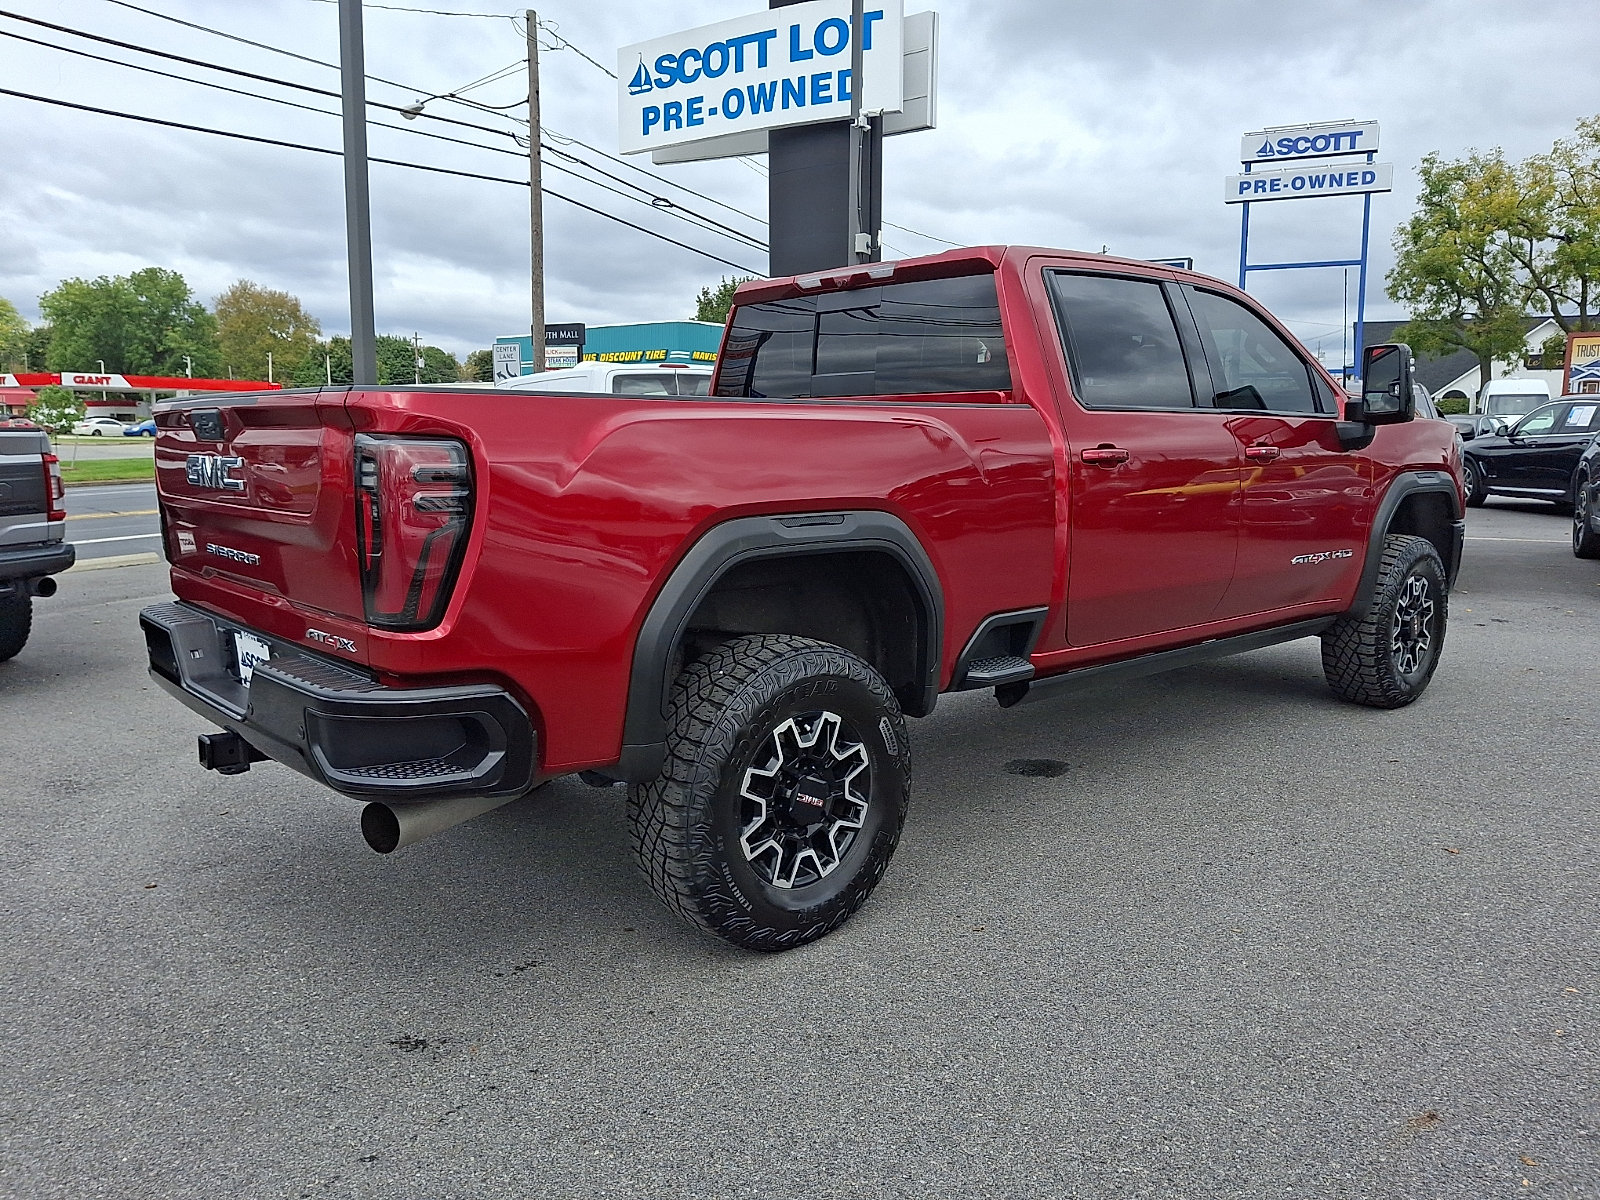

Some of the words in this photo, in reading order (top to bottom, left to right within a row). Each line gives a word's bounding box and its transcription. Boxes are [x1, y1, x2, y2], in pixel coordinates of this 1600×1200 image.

[654, 28, 777, 90] SCOTT
[789, 10, 884, 63] LOT
[1276, 130, 1363, 155] SCOTT
[1238, 170, 1376, 195] PRE-OWNED
[559, 330, 579, 339] MALL
[583, 353, 597, 361] VIS
[599, 351, 643, 362] DISCOUNT
[645, 349, 667, 360] TIRE
[692, 351, 718, 361] MAVIS
[1576, 344, 1600, 358] TRUST
[73, 375, 112, 385] GIANT
[187, 454, 244, 491] GMC
[206, 541, 260, 566] SIERRA
[1332, 548, 1353, 559] HD
[796, 792, 824, 808] GMC
[720, 860, 753, 912] TERRITORY
